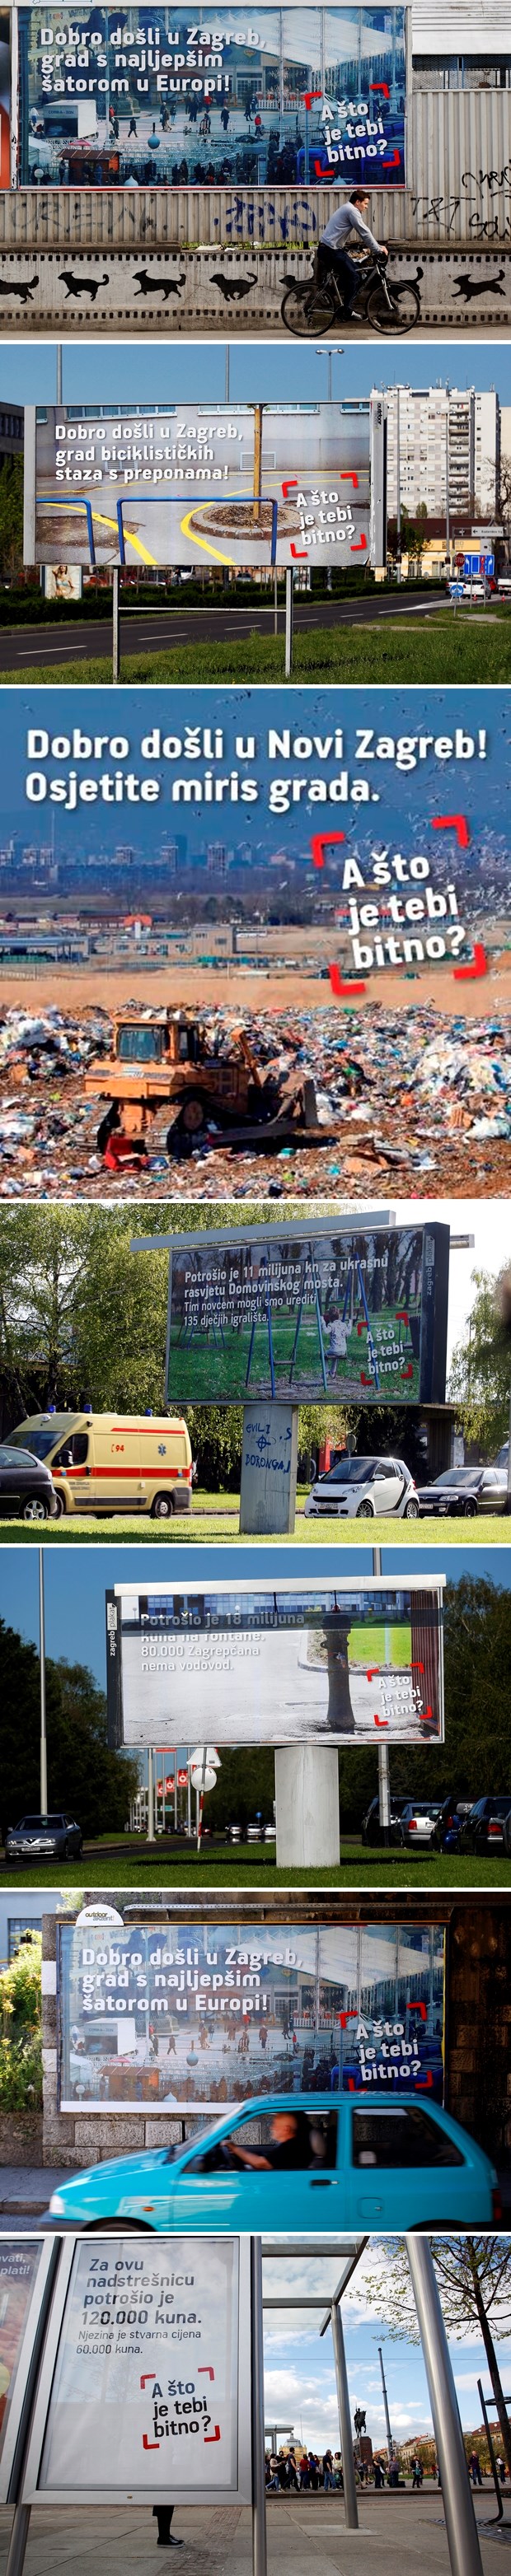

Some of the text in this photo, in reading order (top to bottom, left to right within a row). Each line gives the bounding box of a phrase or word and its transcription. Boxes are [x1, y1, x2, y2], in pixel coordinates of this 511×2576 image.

[41, 28, 266, 52] Dobro došli u Zagreb,
[41, 50, 223, 74] grad s najljepšim
[42, 74, 229, 96] šatorom u Europi!
[321, 100, 368, 121] A što
[325, 118, 384, 145] je tebi
[326, 139, 387, 163] bitno?
[55, 423, 243, 443] Dobro došli u Zagreb,
[55, 444, 213, 467] grad biciklističkih
[55, 465, 228, 483] staza s preponama!
[297, 489, 339, 508] A što
[299, 506, 352, 530] je tebi
[301, 525, 355, 545] bitno?
[27, 727, 487, 771] Dobro došli u Novi Zagreb!
[26, 772, 379, 813] Osjetite miris grada.
[342, 852, 429, 889] A što
[348, 884, 458, 936] je tebi
[352, 925, 466, 969] bitno?
[185, 1258, 387, 1283] Potrošio je 11 milijuna kn za ukrasnu
[185, 1276, 343, 1300] rasvjetu Domovinskog mosta.
[185, 1294, 316, 1312] Tim novcem mogli smo urediti
[184, 1311, 269, 1328] 135 dječjih igrališta.
[366, 1328, 395, 1343] A što
[368, 1340, 403, 1361] je tebi
[368, 1356, 405, 1374] bitno?
[141, 1612, 305, 1628] Potrošio je 18 milijuna
[108, 1607, 116, 1656] zagreb plakat
[141, 1643, 259, 1659] 80.000 Zagrepčana
[141, 1659, 233, 1671] nema vodovod.
[378, 1675, 410, 1689] A što
[381, 1686, 420, 1705] je tebi
[382, 1700, 424, 1717] bitno?
[82, 1948, 303, 1971] Dobro došli u Zagreb,
[82, 1970, 260, 1993] grad s najljepšim
[82, 1995, 267, 2014] šatorom u Europi!
[356, 2020, 404, 2040] A što
[359, 2039, 419, 2064] je tebi
[360, 2060, 421, 2081] bitno?
[0, 2253, 26, 2264] vati,
[89, 2259, 143, 2271] Za ovu
[0, 2266, 30, 2275] plati!
[87, 2273, 195, 2288] nadstrešnicu
[83, 2290, 174, 2308] potrošio je
[82, 2310, 202, 2326] 120.000 kuna.
[78, 2329, 201, 2341] Njezina je stvarna cijena
[76, 2345, 143, 2354] 60.000 kuna.
[152, 2379, 195, 2398] A što
[152, 2396, 207, 2420] je tebi
[153, 2415, 211, 2438] bitno?
